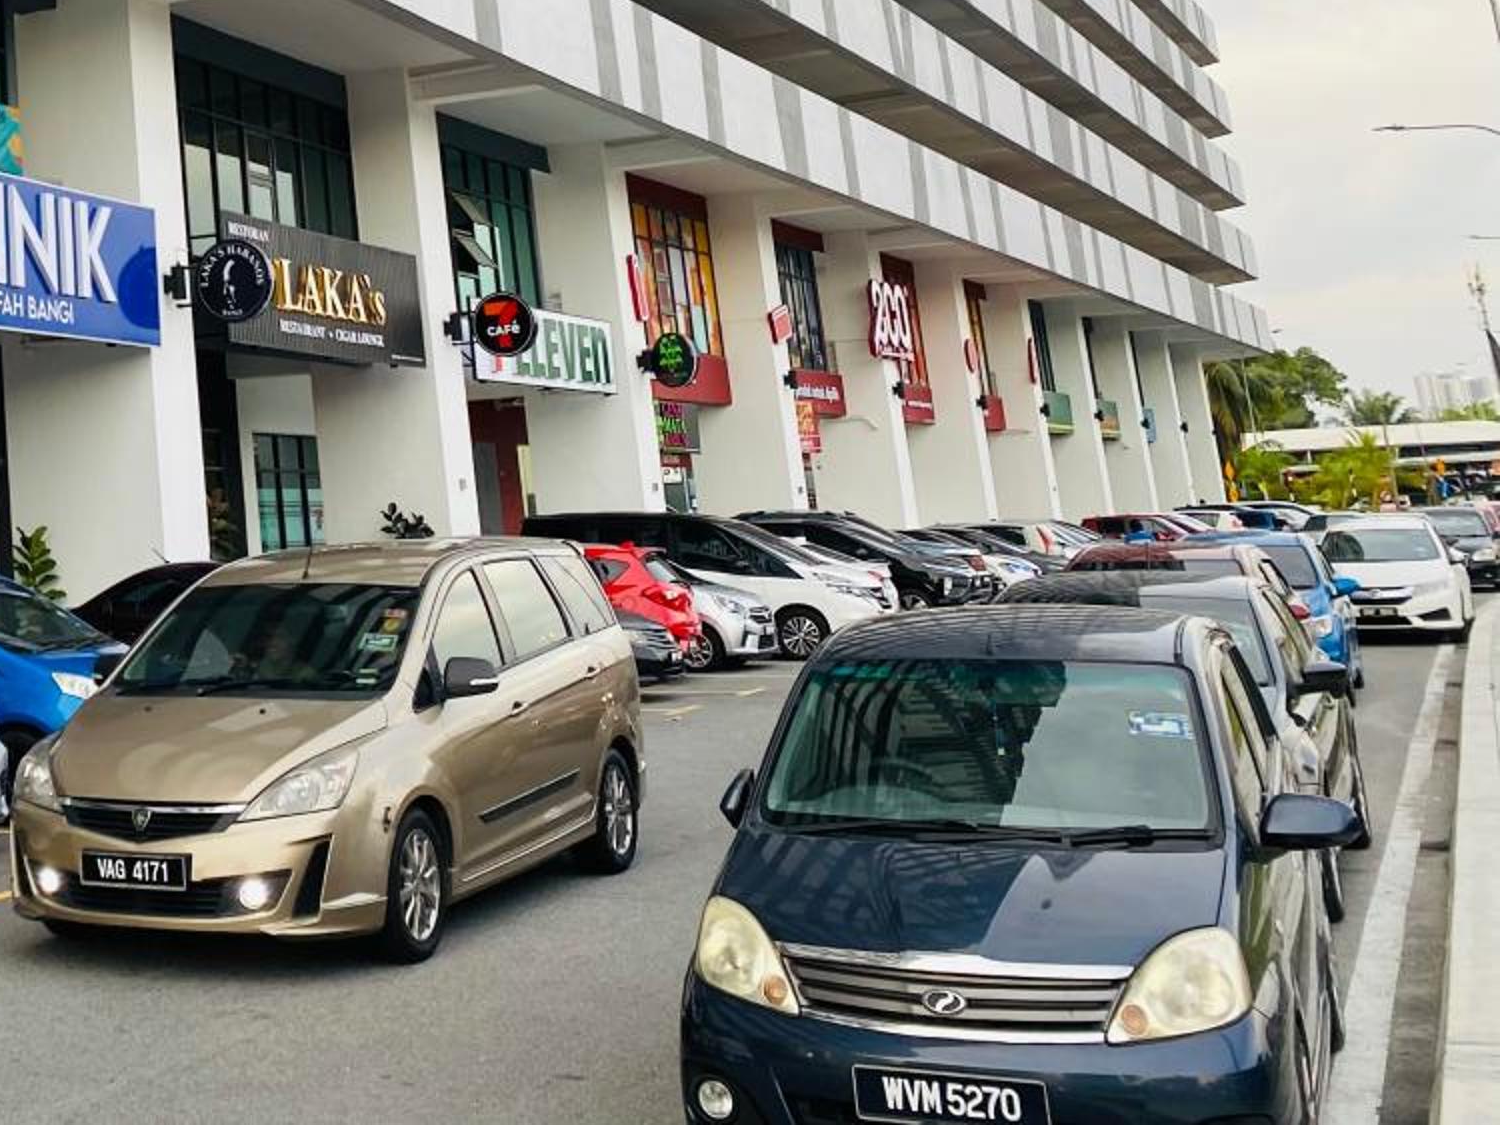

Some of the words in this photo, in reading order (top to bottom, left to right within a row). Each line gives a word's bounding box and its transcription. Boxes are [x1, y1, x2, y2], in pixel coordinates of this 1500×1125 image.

[27, 292, 75, 325] BANGI
[97, 857, 126, 880] VAG
[132, 860, 169, 883] 4171
[882, 1075, 943, 1115] WVM
[947, 1083, 1022, 1122] 5270
